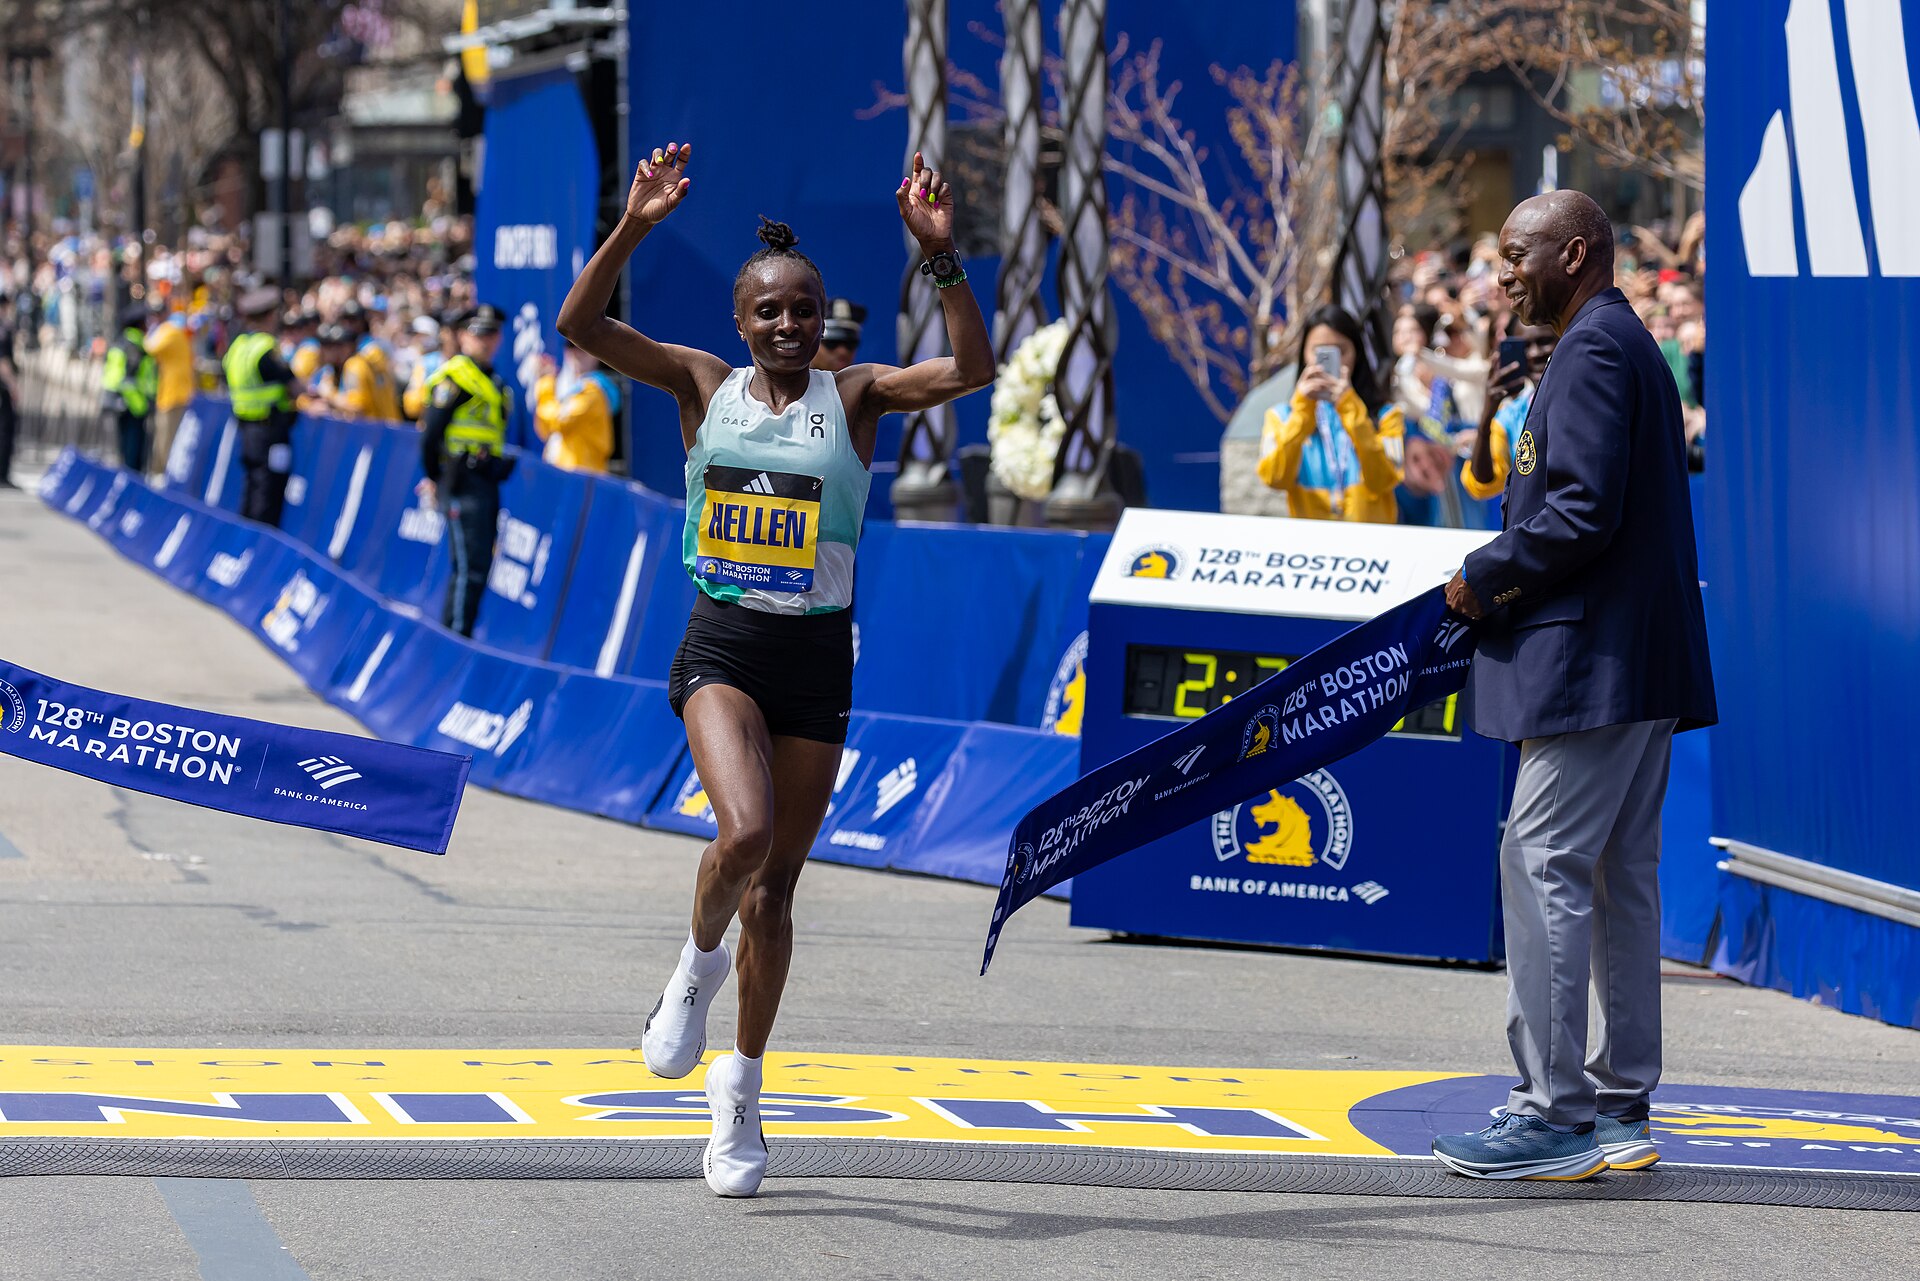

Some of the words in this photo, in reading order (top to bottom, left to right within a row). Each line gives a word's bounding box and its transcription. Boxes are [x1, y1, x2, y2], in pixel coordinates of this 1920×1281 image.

[721, 417, 749, 427] OAC
[735, 564, 771, 575] BOSTON
[1199, 548, 1260, 565] 128TH
[1266, 552, 1390, 574] BOSTON
[1282, 679, 1317, 717] 128TH
[1320, 642, 1409, 697] BOSTON
[1418, 666, 1439, 677] ANK
[1447, 658, 1472, 669] AMER
[37, 699, 104, 730] 128TH
[108, 717, 241, 758] BOSTON
[274, 788, 303, 800] BANK
[305, 794, 319, 802] OF
[320, 797, 368, 811] AMERICA
[1154, 788, 1173, 801] BANK
[1173, 784, 1183, 793] OF
[1038, 815, 1076, 853] 128TH
[1073, 774, 1150, 828] BOSTON
[1217, 810, 1232, 849] THE
[1190, 875, 1240, 893] BANK
[1242, 879, 1267, 895] OF
[1268, 881, 1350, 902] AMERICA
[462, 1059, 1245, 1084] MAATHON
